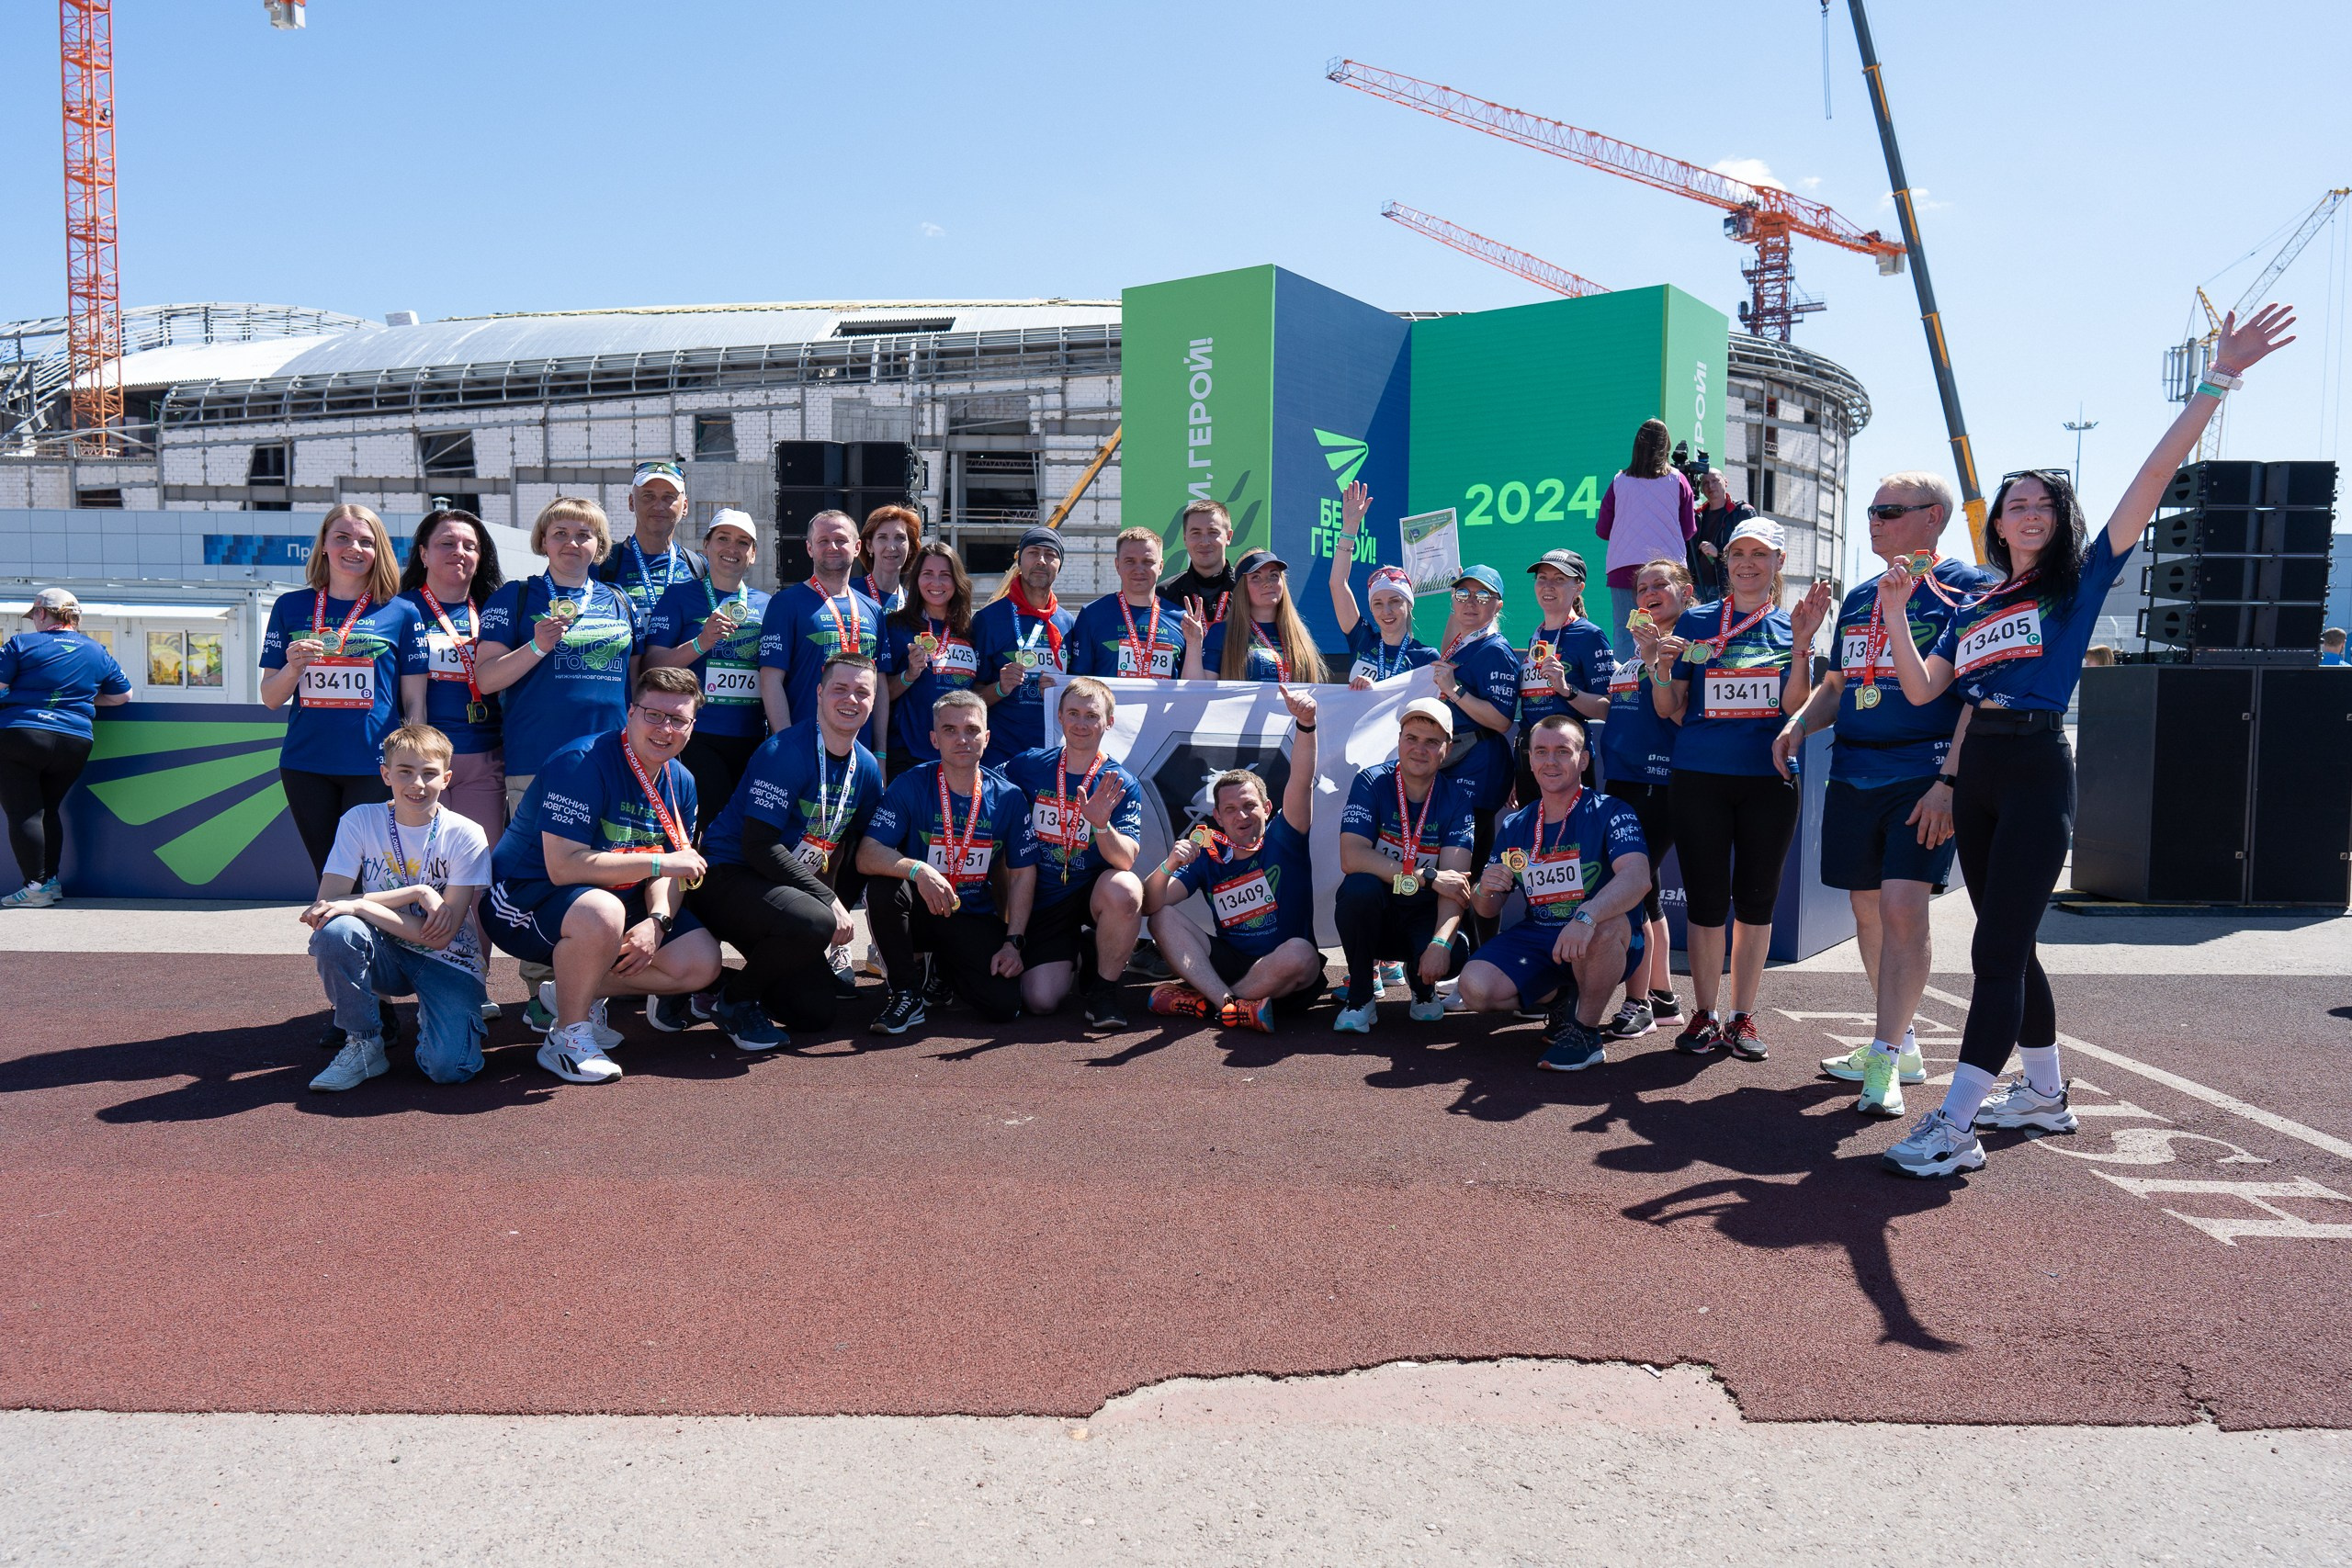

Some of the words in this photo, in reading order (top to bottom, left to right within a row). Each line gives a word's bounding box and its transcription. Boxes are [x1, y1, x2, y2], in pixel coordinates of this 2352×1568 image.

[1183, 336, 1214, 468] ГЕРОЙ!
[1693, 360, 1707, 463] ЕРОЙ!
[1464, 475, 1601, 526] 2024
[287, 543, 311, 560] Пр
[1310, 526, 1378, 565] ГЕОЙ!
[553, 637, 628, 657] ЭТОТ
[1963, 616, 2031, 656] 13405
[554, 654, 623, 672] ГОРОД
[1125, 651, 1169, 669] 198
[304, 671, 367, 690] 13410
[717, 673, 756, 690] 2076
[1713, 682, 1770, 700] 13411
[624, 742, 640, 769] ГЕРОИ
[636, 767, 660, 802] МЕНЯЮТ
[655, 803, 671, 824] ЭТОТ
[753, 778, 788, 797] НИЖНИЙ
[938, 772, 947, 795] ГЕРОИ
[547, 791, 590, 814] НИЖНИЙ
[749, 785, 790, 809] НОВГОРОД
[753, 796, 775, 810] 2024
[542, 799, 592, 825] НОВГОРОД
[551, 812, 574, 826] 2024
[942, 795, 952, 828] МЕНЯЮТ
[962, 823, 973, 849] ГЕРОИ
[969, 791, 981, 824] МЕНЯЮТ
[1038, 809, 1086, 832] 139
[391, 835, 403, 866] МЕНЯЮТ
[944, 828, 954, 850] ЭТОТ
[935, 851, 984, 867] 151
[1527, 865, 1576, 888] 13450
[1218, 884, 1264, 911] 13409
